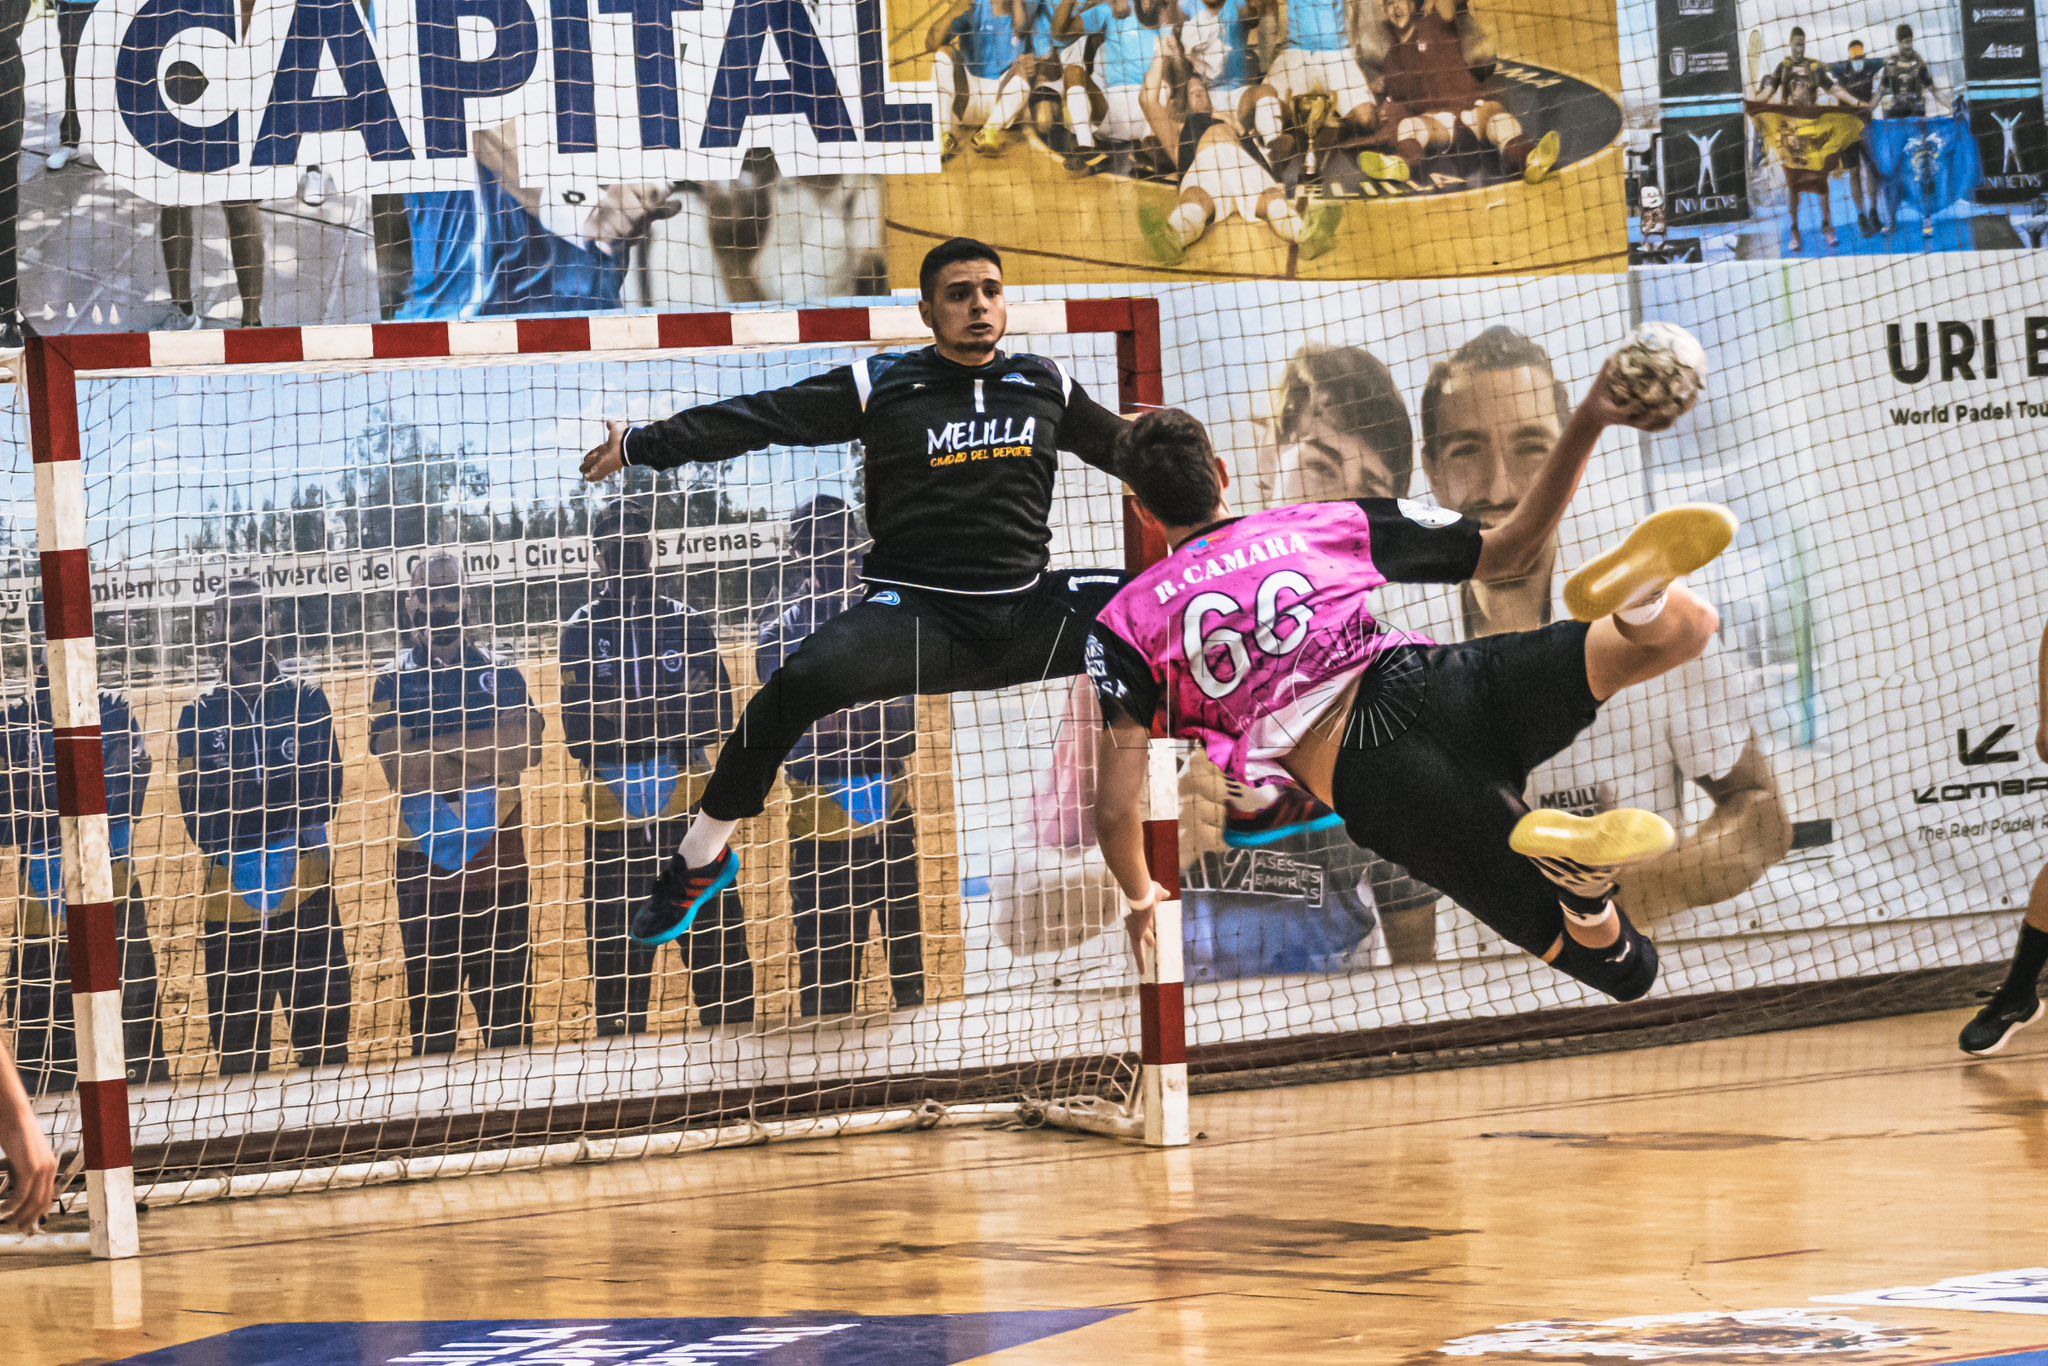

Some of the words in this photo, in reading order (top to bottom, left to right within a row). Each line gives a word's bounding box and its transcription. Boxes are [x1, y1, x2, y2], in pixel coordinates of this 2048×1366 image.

[117, 0, 935, 173] CAPITAL
[1294, 172, 1468, 198] ELILLA
[1886, 318, 1998, 385] URI
[1889, 404, 1949, 426] World
[1956, 402, 2012, 423] Padel
[927, 416, 1036, 455] MELILLA
[930, 453, 968, 468] CIUDAD
[971, 449, 989, 462] DEL
[993, 446, 1033, 460] DEPORTE
[193, 571, 220, 596] de
[358, 555, 395, 582] del
[676, 531, 762, 555] Arenas
[1153, 533, 1309, 606] R.CAMARA
[1182, 569, 1317, 700] 66
[1539, 786, 1598, 809] MELILL
[1917, 825, 1945, 843] The
[1950, 820, 1985, 840] Real
[1991, 815, 2035, 835] Padel
